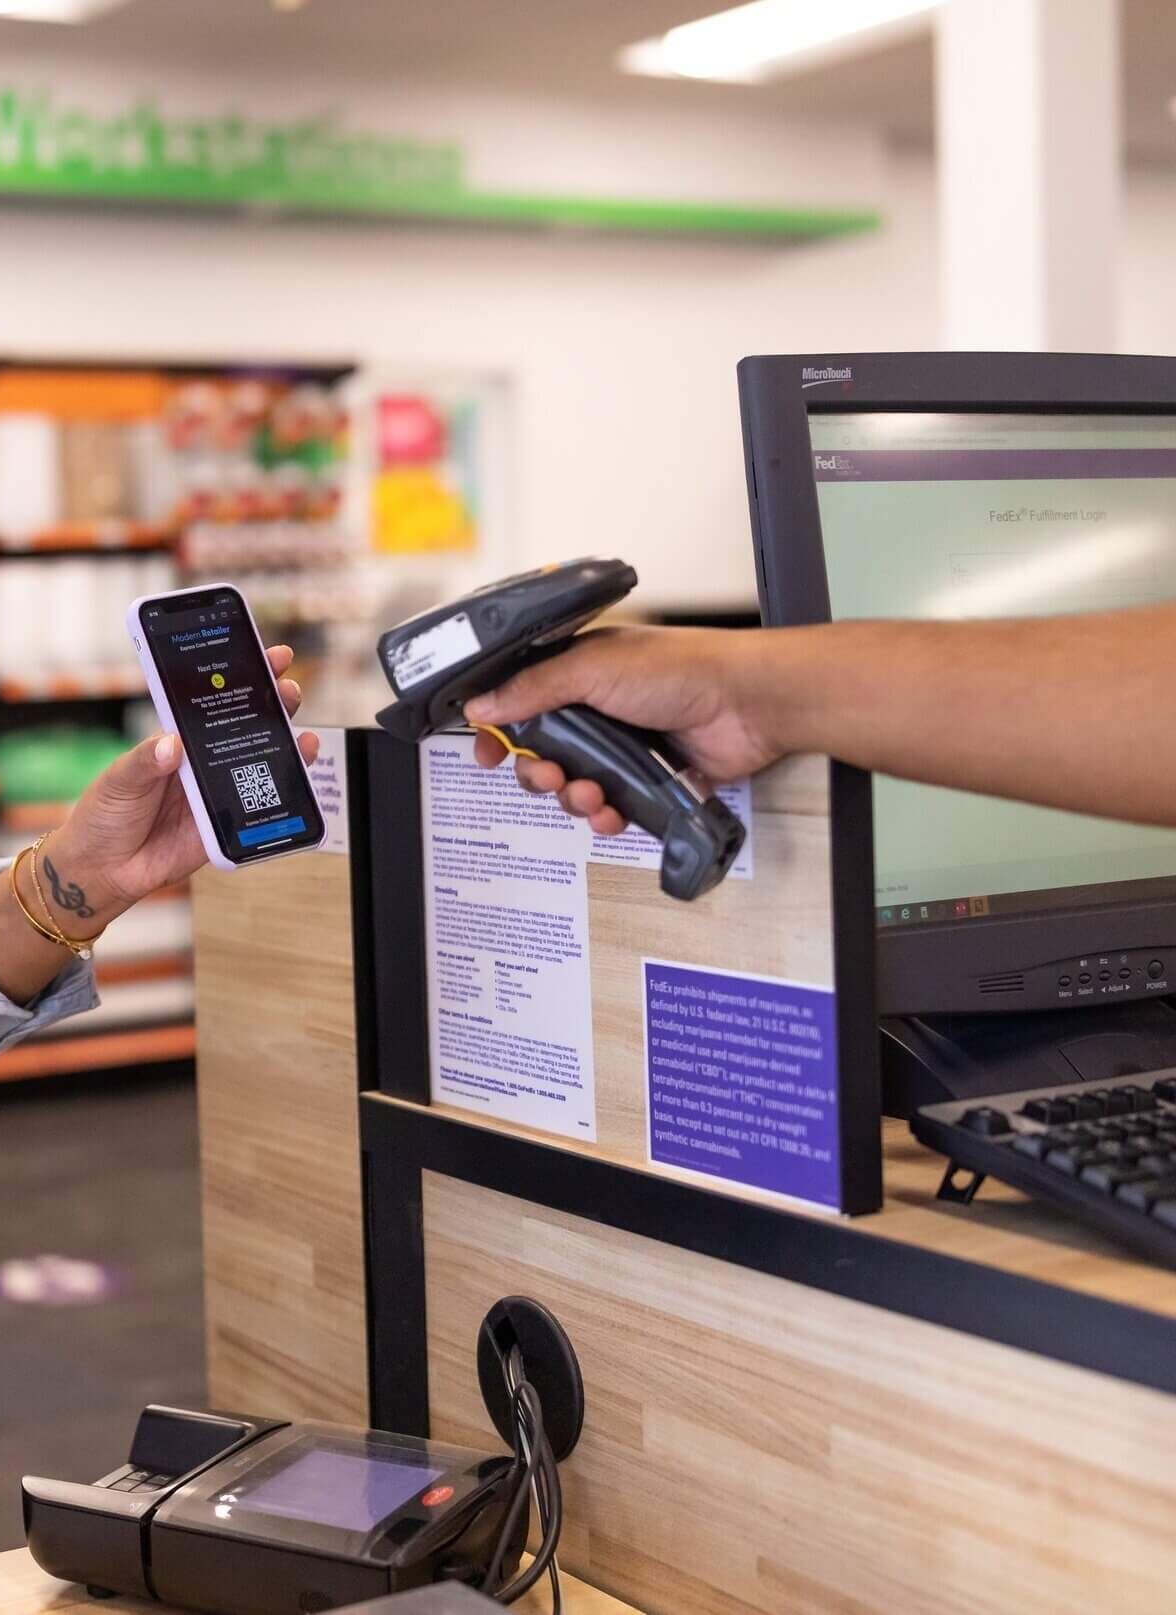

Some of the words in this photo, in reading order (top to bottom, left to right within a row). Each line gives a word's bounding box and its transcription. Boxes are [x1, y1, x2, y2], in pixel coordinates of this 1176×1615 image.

[802, 367, 852, 380] MicroTouch
[199, 623, 231, 638] Retailer
[197, 663, 211, 672] Next
[210, 660, 229, 670] Steps
[446, 751, 460, 759] policy
[434, 885, 457, 896] Shredding
[649, 978, 672, 994] FedEx
[673, 982, 705, 1001] prohibits
[707, 988, 747, 1008] shipments
[748, 995, 757, 1008] of
[1146, 980, 1168, 991] POWER
[650, 997, 677, 1013] defined
[679, 1002, 689, 1017] by
[706, 1007, 733, 1024] federal
[651, 1014, 683, 1035] including
[684, 1022, 722, 1043] marijuana
[651, 1036, 659, 1047] or
[660, 1036, 696, 1055] medicinal
[712, 1046, 727, 1061] and
[652, 1054, 694, 1073] cannabidiol
[653, 1091, 661, 1102] of
[662, 1093, 680, 1107] more
[682, 1095, 699, 1111] than
[655, 1127, 688, 1148] synthetic
